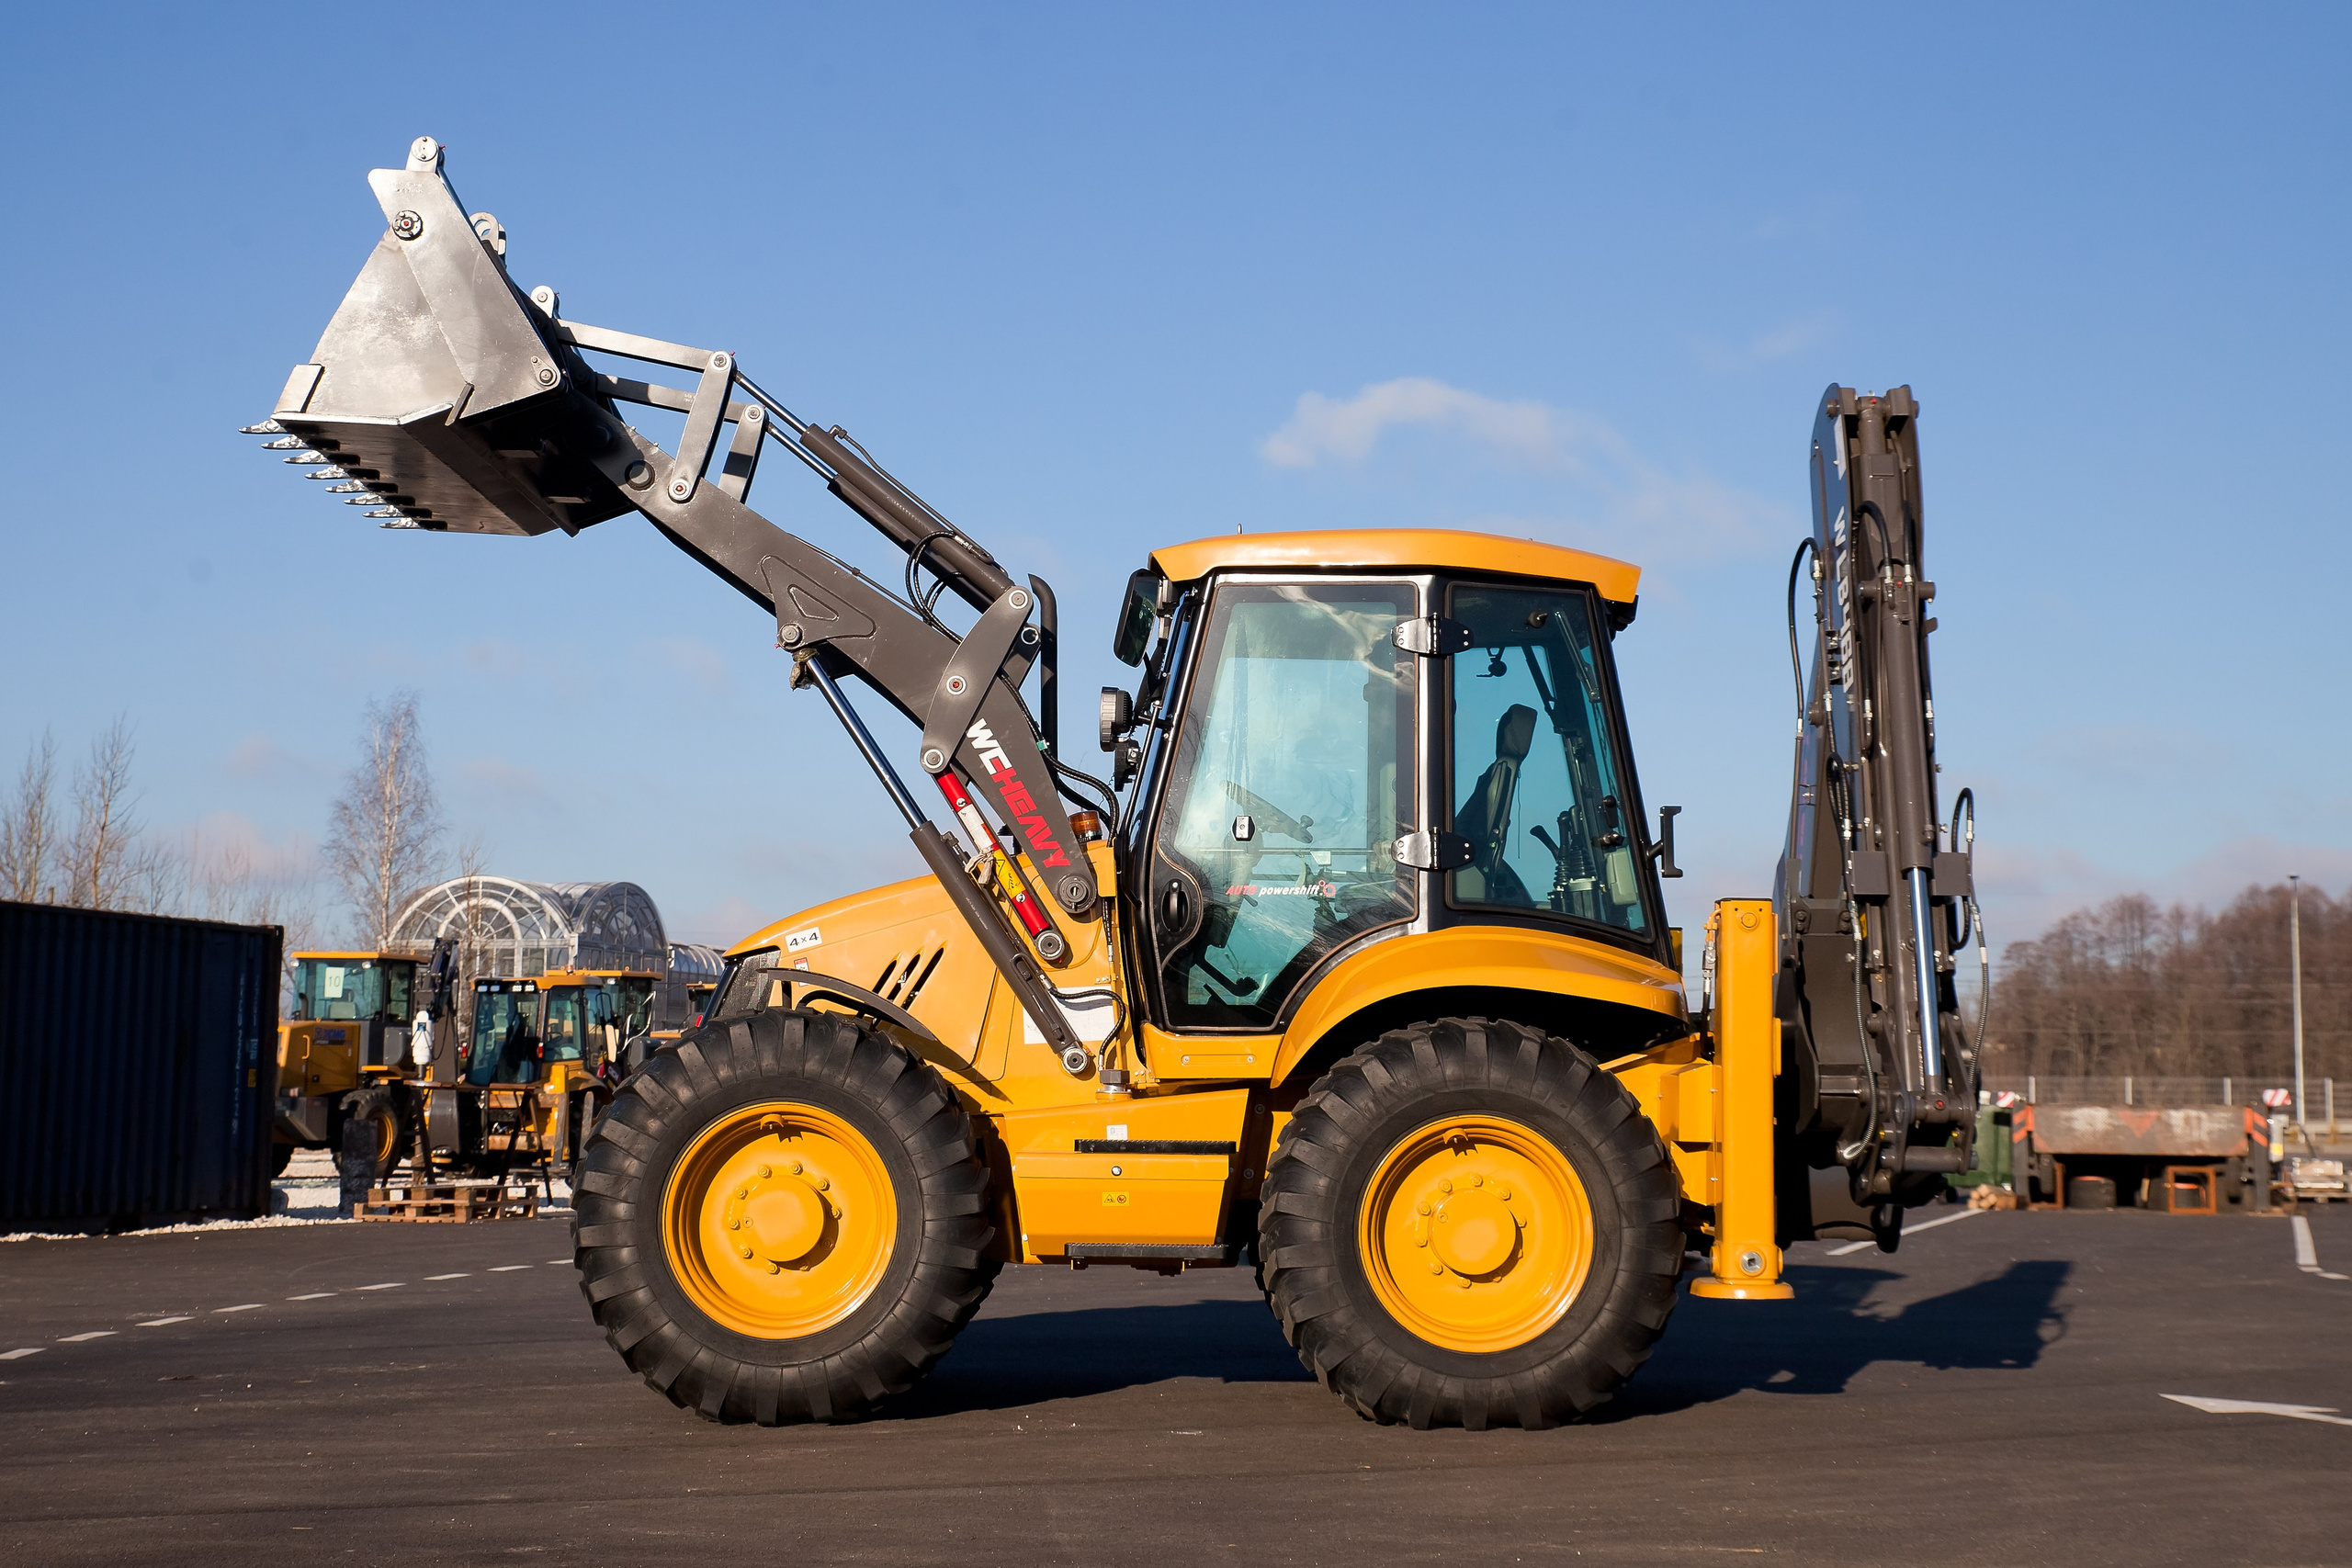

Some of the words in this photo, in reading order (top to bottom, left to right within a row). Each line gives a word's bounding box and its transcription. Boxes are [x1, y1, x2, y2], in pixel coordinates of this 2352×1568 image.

[1225, 885, 1258, 896] AUTO
[1259, 885, 1320, 897] powershift
[328, 976, 341, 987] 10
